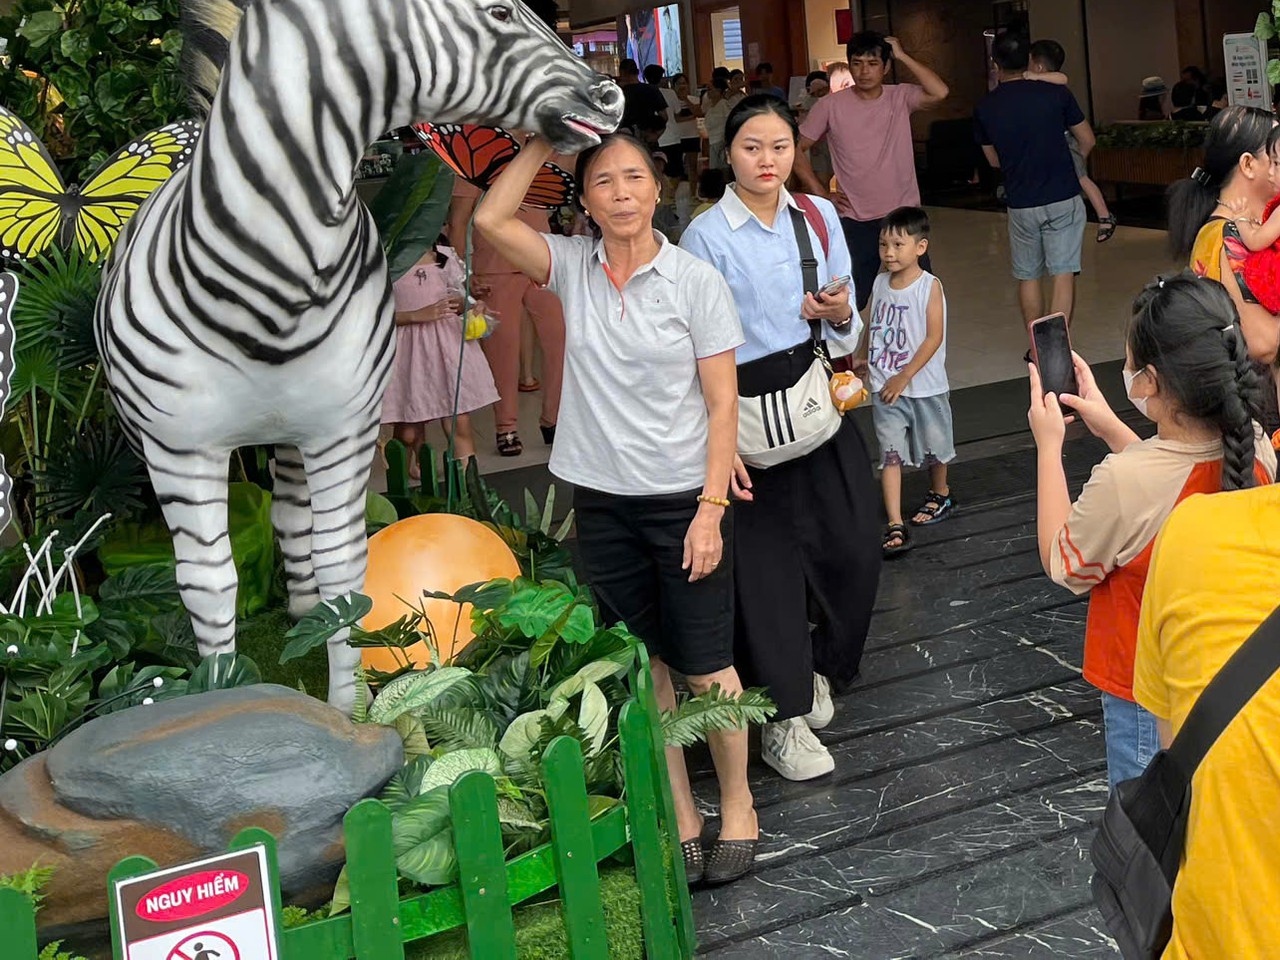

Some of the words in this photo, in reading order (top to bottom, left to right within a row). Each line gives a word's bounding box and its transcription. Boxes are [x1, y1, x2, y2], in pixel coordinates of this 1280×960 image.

[871, 300, 910, 329] NOT
[869, 326, 906, 350] TOO
[146, 887, 193, 914] NGUY
[196, 872, 239, 900] HIỂM
